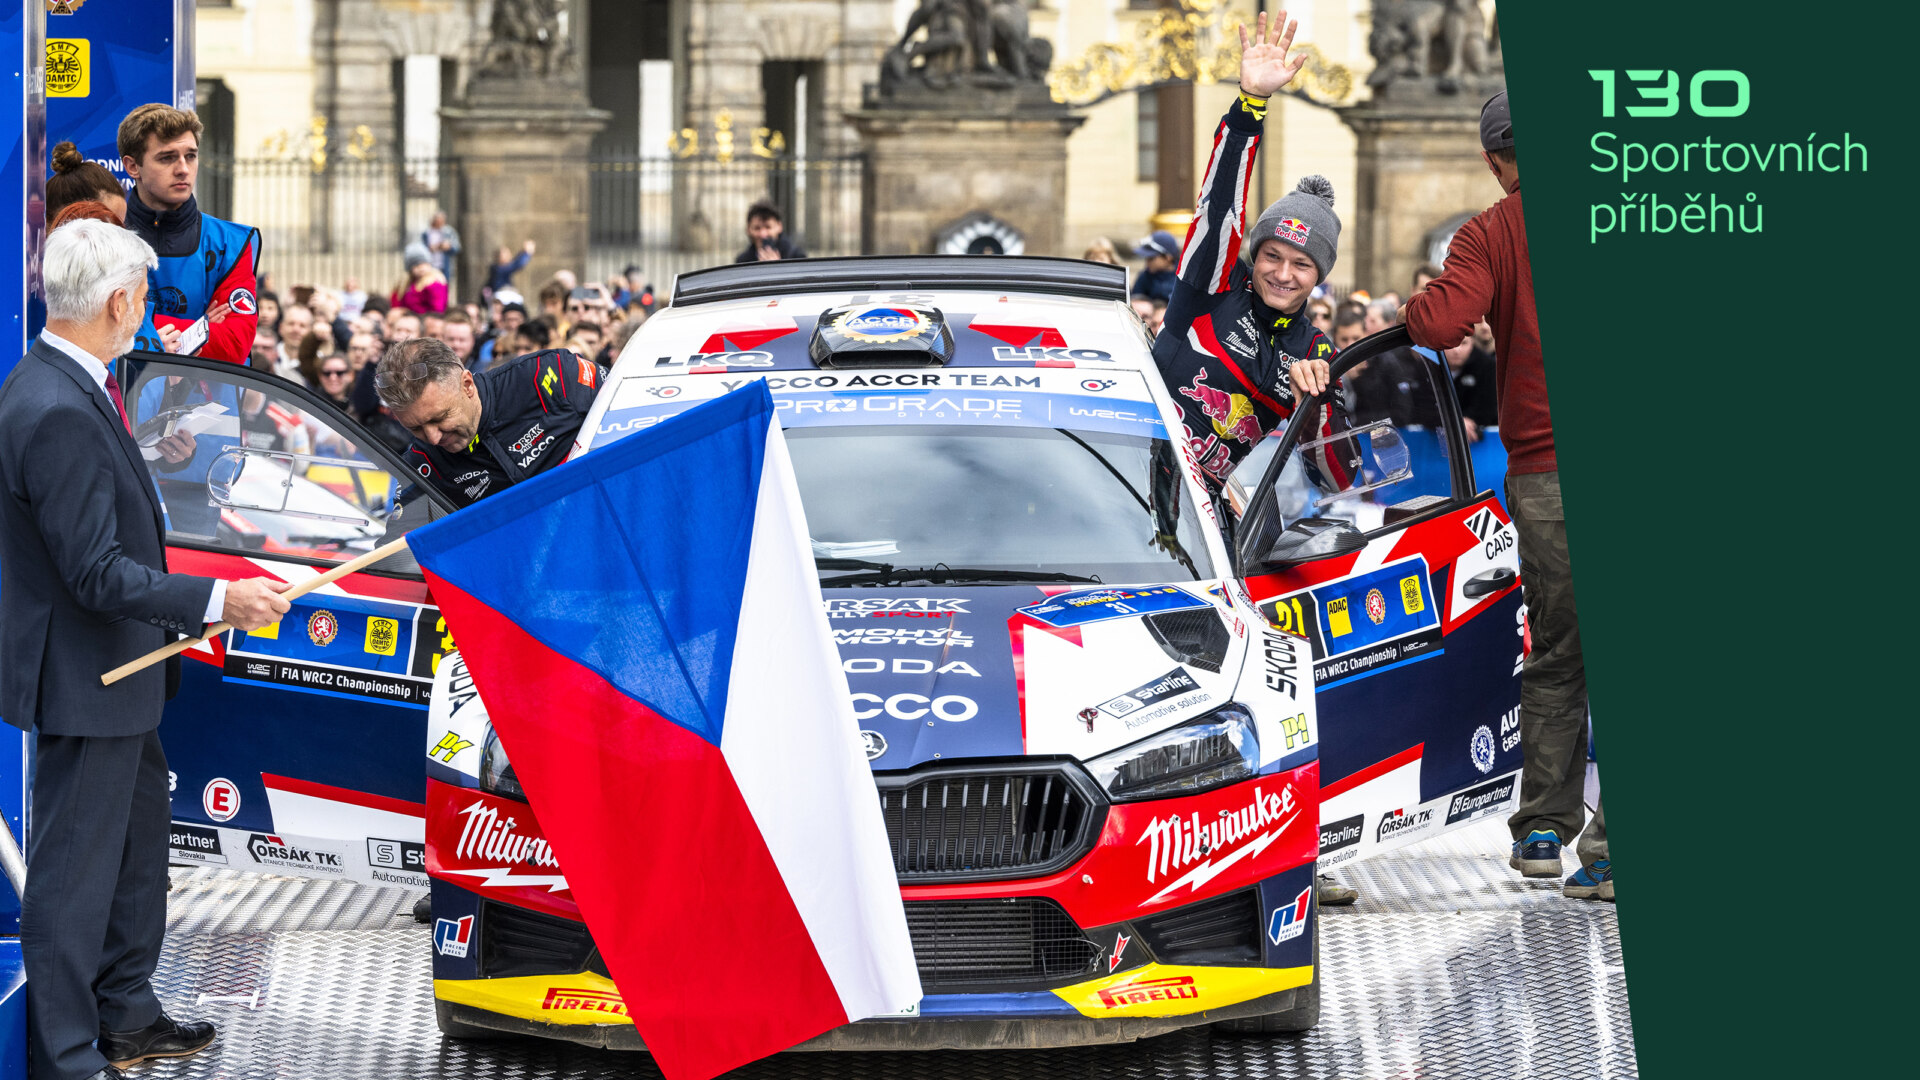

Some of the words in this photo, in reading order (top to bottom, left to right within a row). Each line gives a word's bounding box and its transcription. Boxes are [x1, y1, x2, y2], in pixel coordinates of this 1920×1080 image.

[1275, 227, 1292, 240] Red
[1291, 232, 1308, 246] Bull
[655, 350, 774, 368] LKQ
[994, 346, 1115, 364] LKQ
[846, 374, 941, 387] ACCR
[948, 374, 1041, 388] TEAM
[897, 411, 1021, 420] DIGITAL
[517, 436, 555, 468] YACCO
[1486, 531, 1513, 560] CAIS
[1328, 599, 1347, 615] ADAC
[1314, 667, 1328, 681] FIA
[1328, 661, 1349, 677] WRC2
[1349, 646, 1397, 670] Championship
[281, 667, 300, 681] FIA
[302, 669, 333, 686] WRC2
[336, 675, 411, 698] Championship
[1135, 675, 1192, 700] Starline
[1124, 705, 1178, 730] Automotive
[1177, 692, 1212, 709] solution
[213, 787, 230, 812] E
[1460, 784, 1512, 813] Europartner
[1419, 809, 1432, 823] TK
[1136, 784, 1297, 884] Milwaukee
[1319, 826, 1360, 848] Starline
[178, 851, 206, 860] Slovakia
[256, 845, 312, 863] ORSÁK
[315, 852, 338, 866] TK
[263, 858, 285, 867] STANICE
[1332, 849, 1358, 865] solution
[542, 987, 629, 1017] PIRELL
[1097, 975, 1199, 1010] PIRELLI
